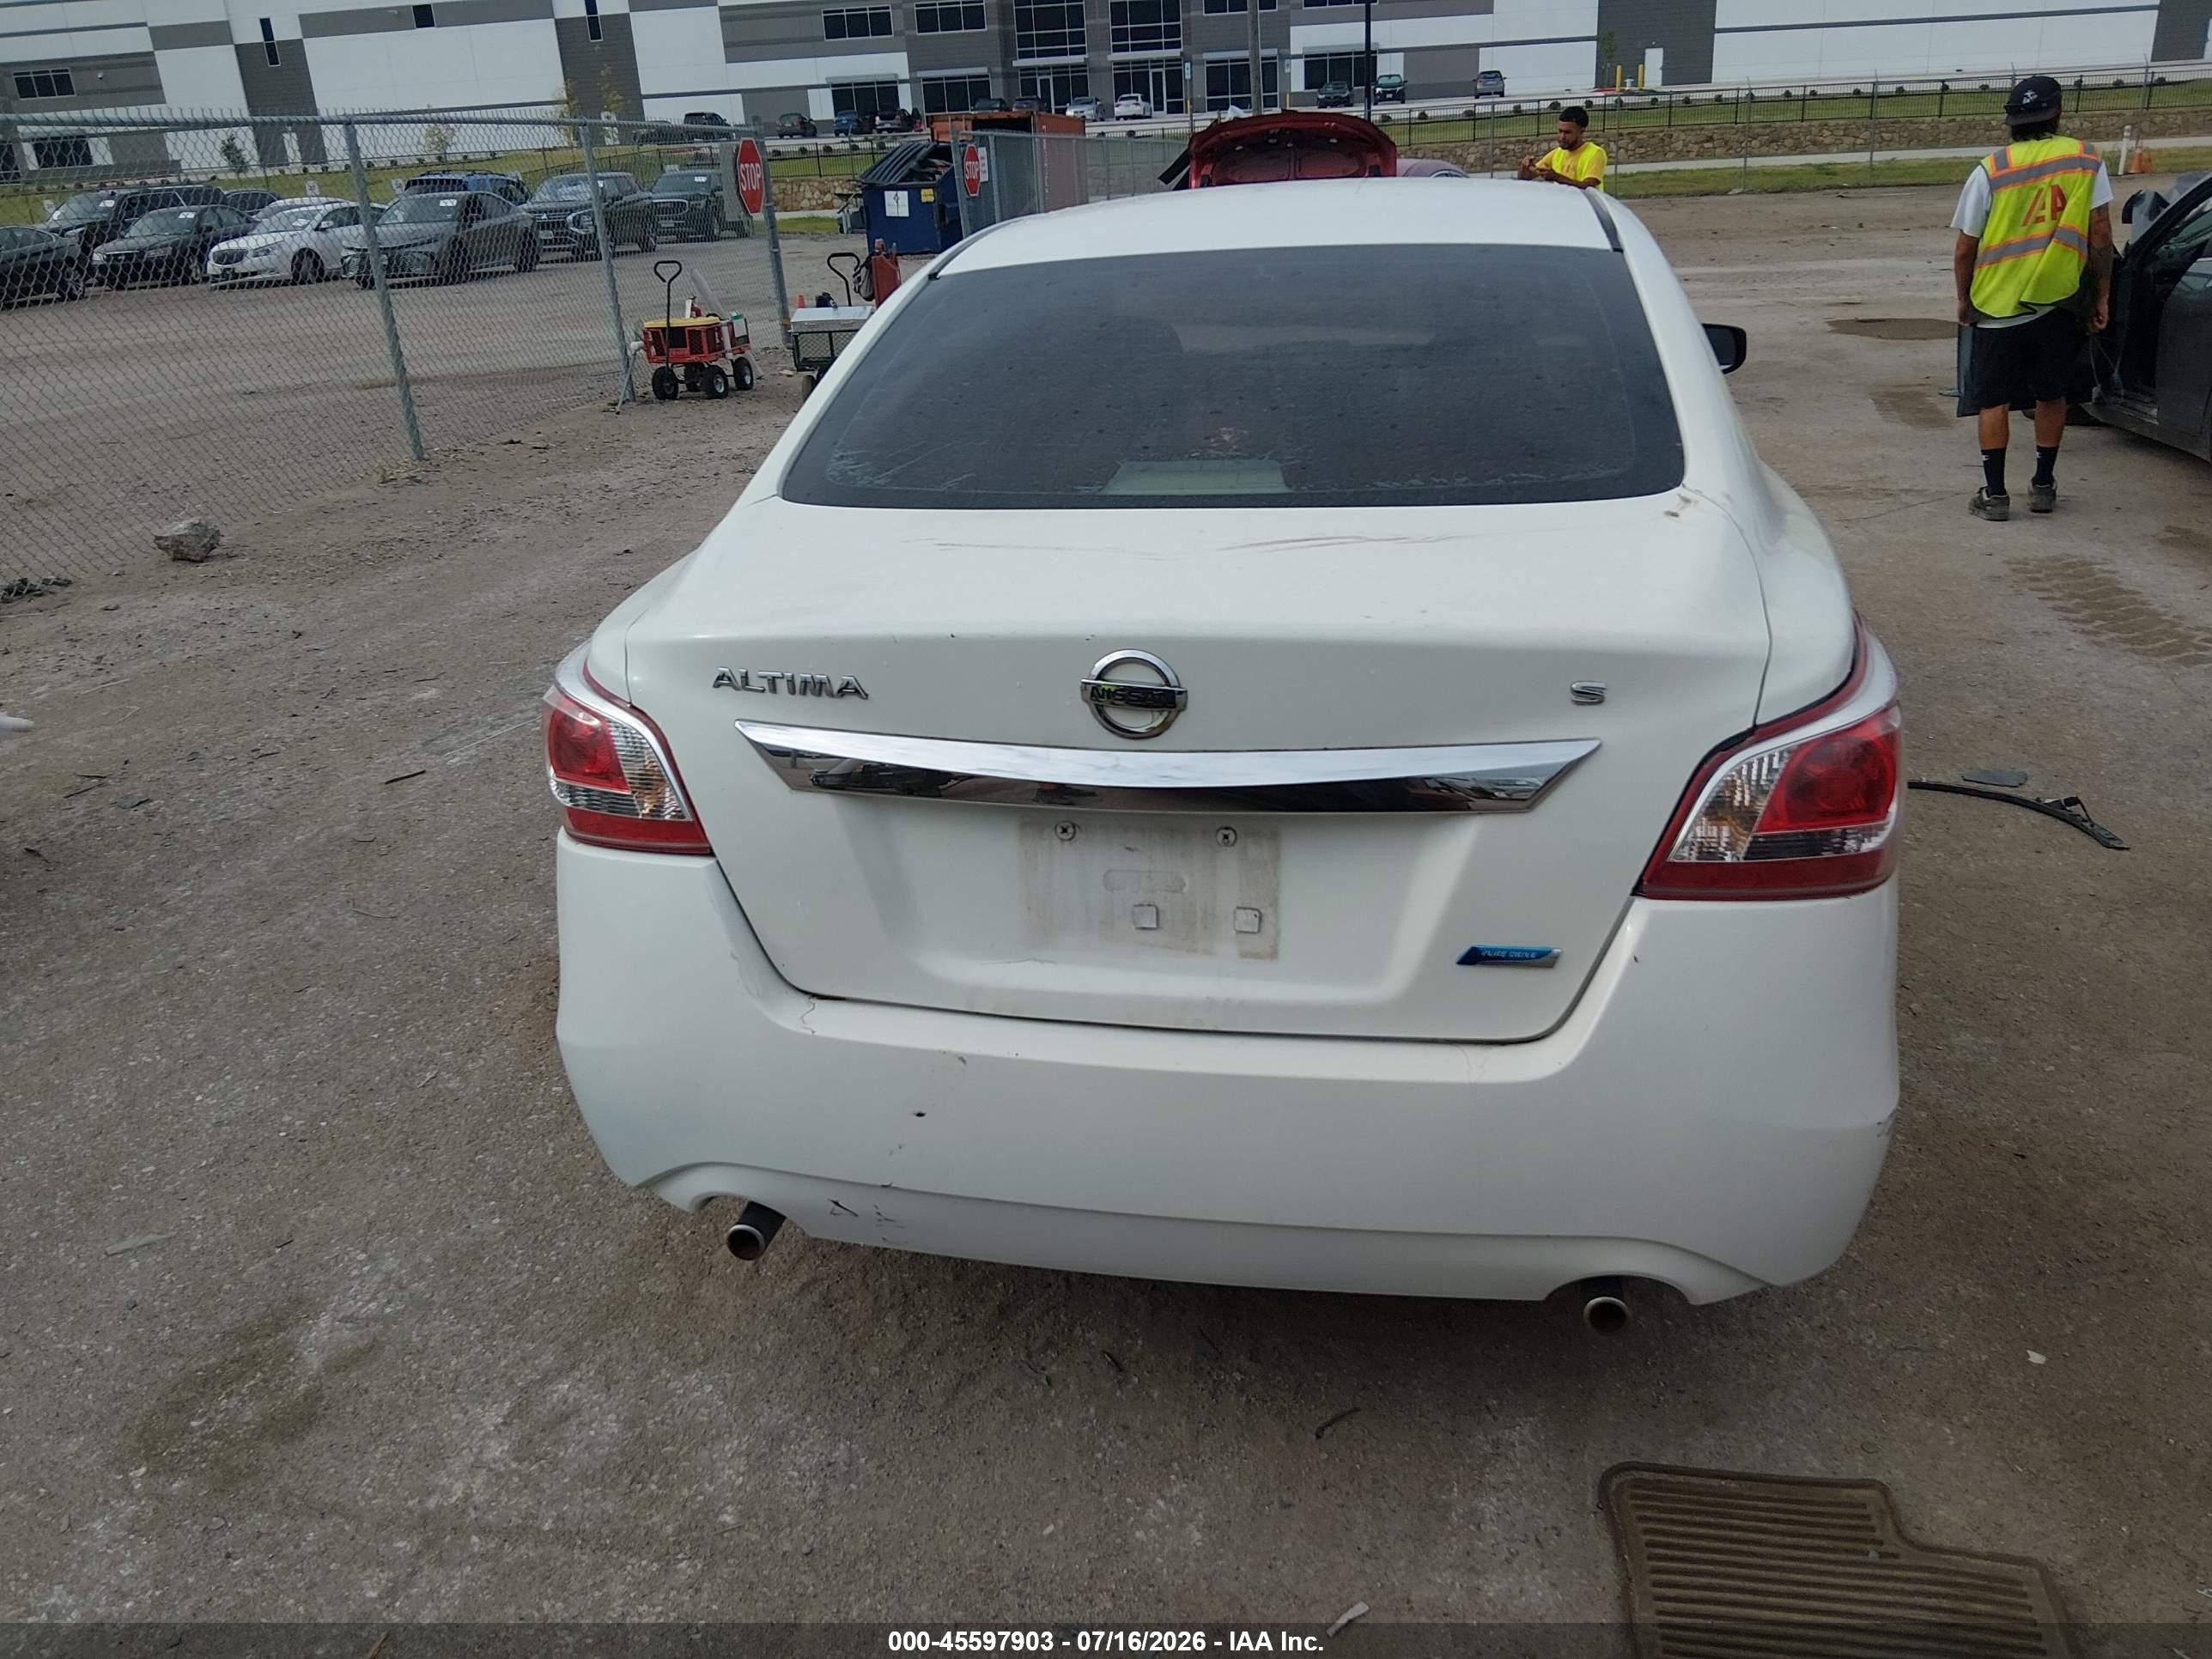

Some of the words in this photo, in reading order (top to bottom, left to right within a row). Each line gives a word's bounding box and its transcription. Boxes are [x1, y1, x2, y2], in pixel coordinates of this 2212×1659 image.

[740, 162, 762, 191] STOP
[965, 161, 979, 179] STOP
[713, 666, 869, 700] ALTIMA
[1571, 681, 1606, 706] S
[1090, 684, 1176, 709] NISSAN
